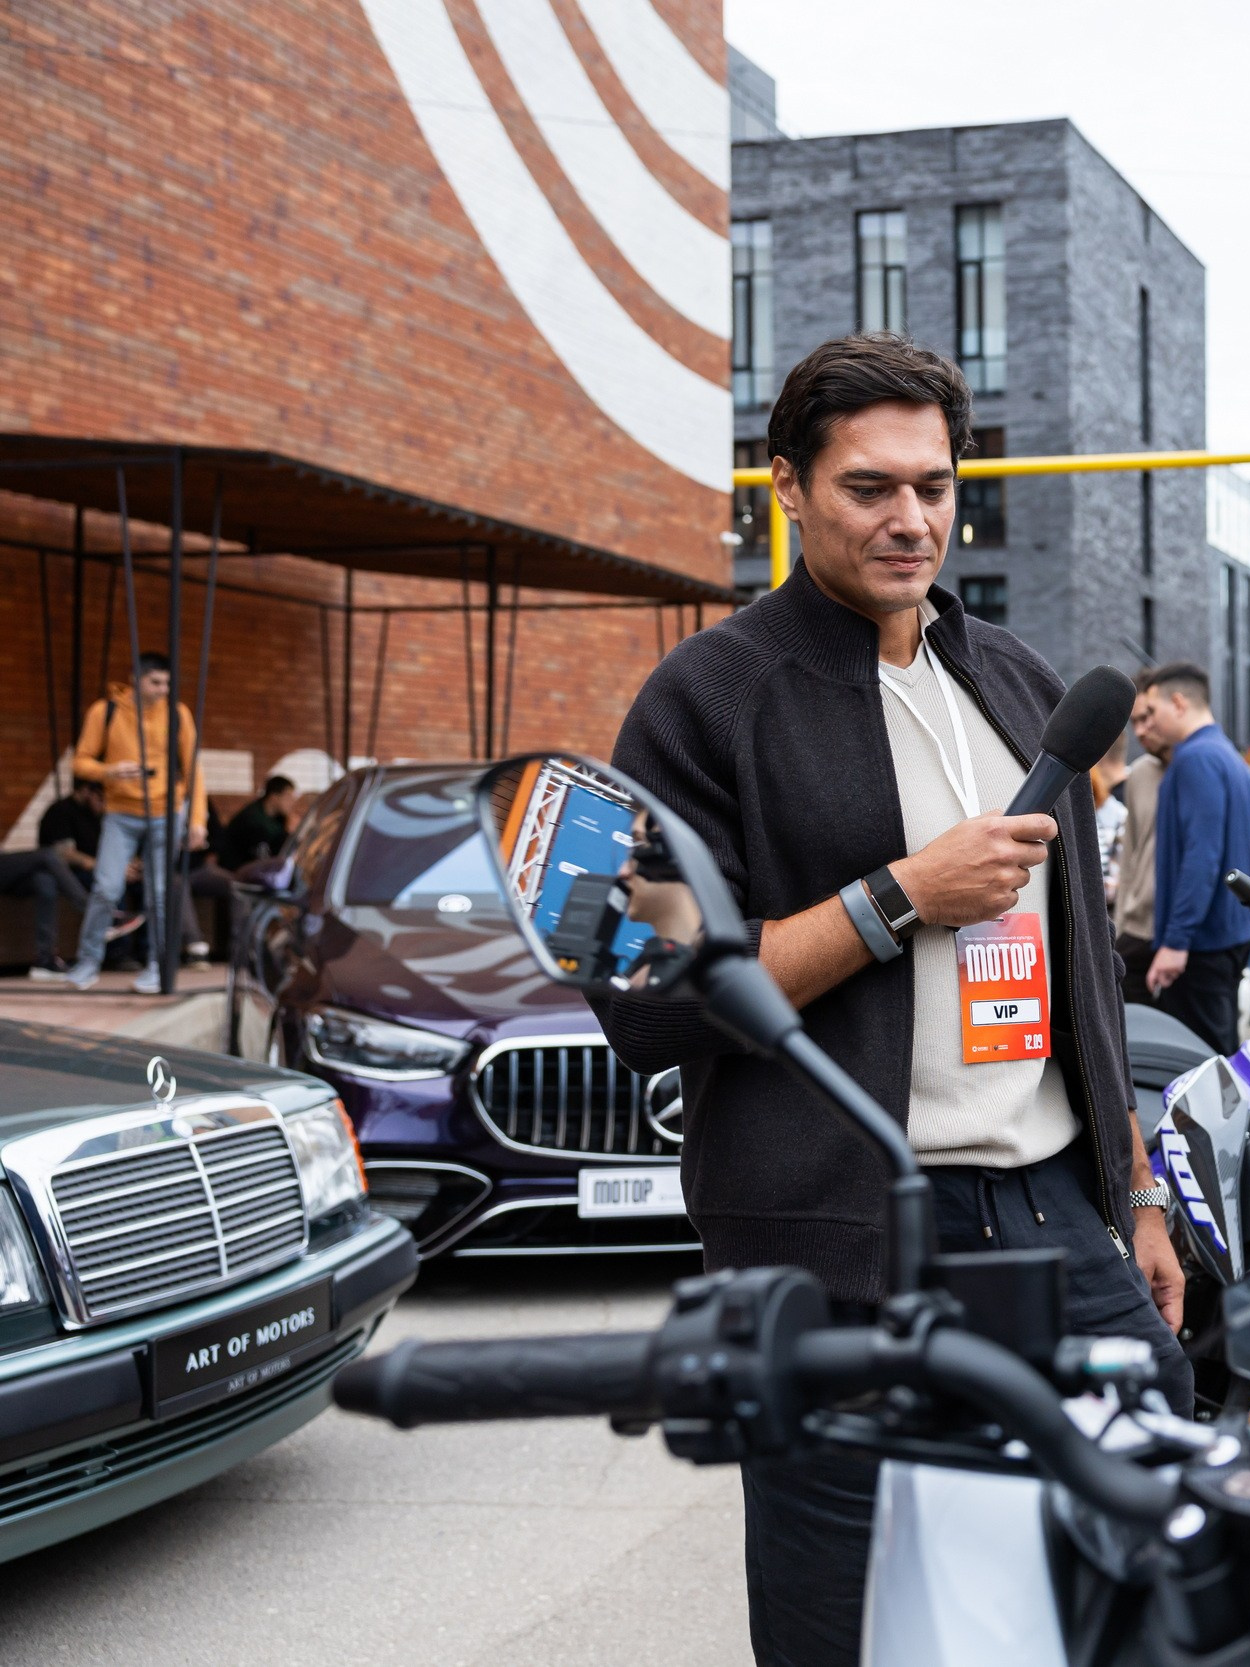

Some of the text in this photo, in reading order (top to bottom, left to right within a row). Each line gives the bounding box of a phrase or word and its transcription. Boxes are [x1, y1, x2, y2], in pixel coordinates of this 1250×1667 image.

[966, 943, 1037, 982] МОТОР
[994, 1005, 1018, 1019] VIP
[1024, 1034, 1043, 1050] 12.09
[593, 1178, 653, 1204] МОТОР
[185, 1306, 315, 1373] ART OF MOTORS
